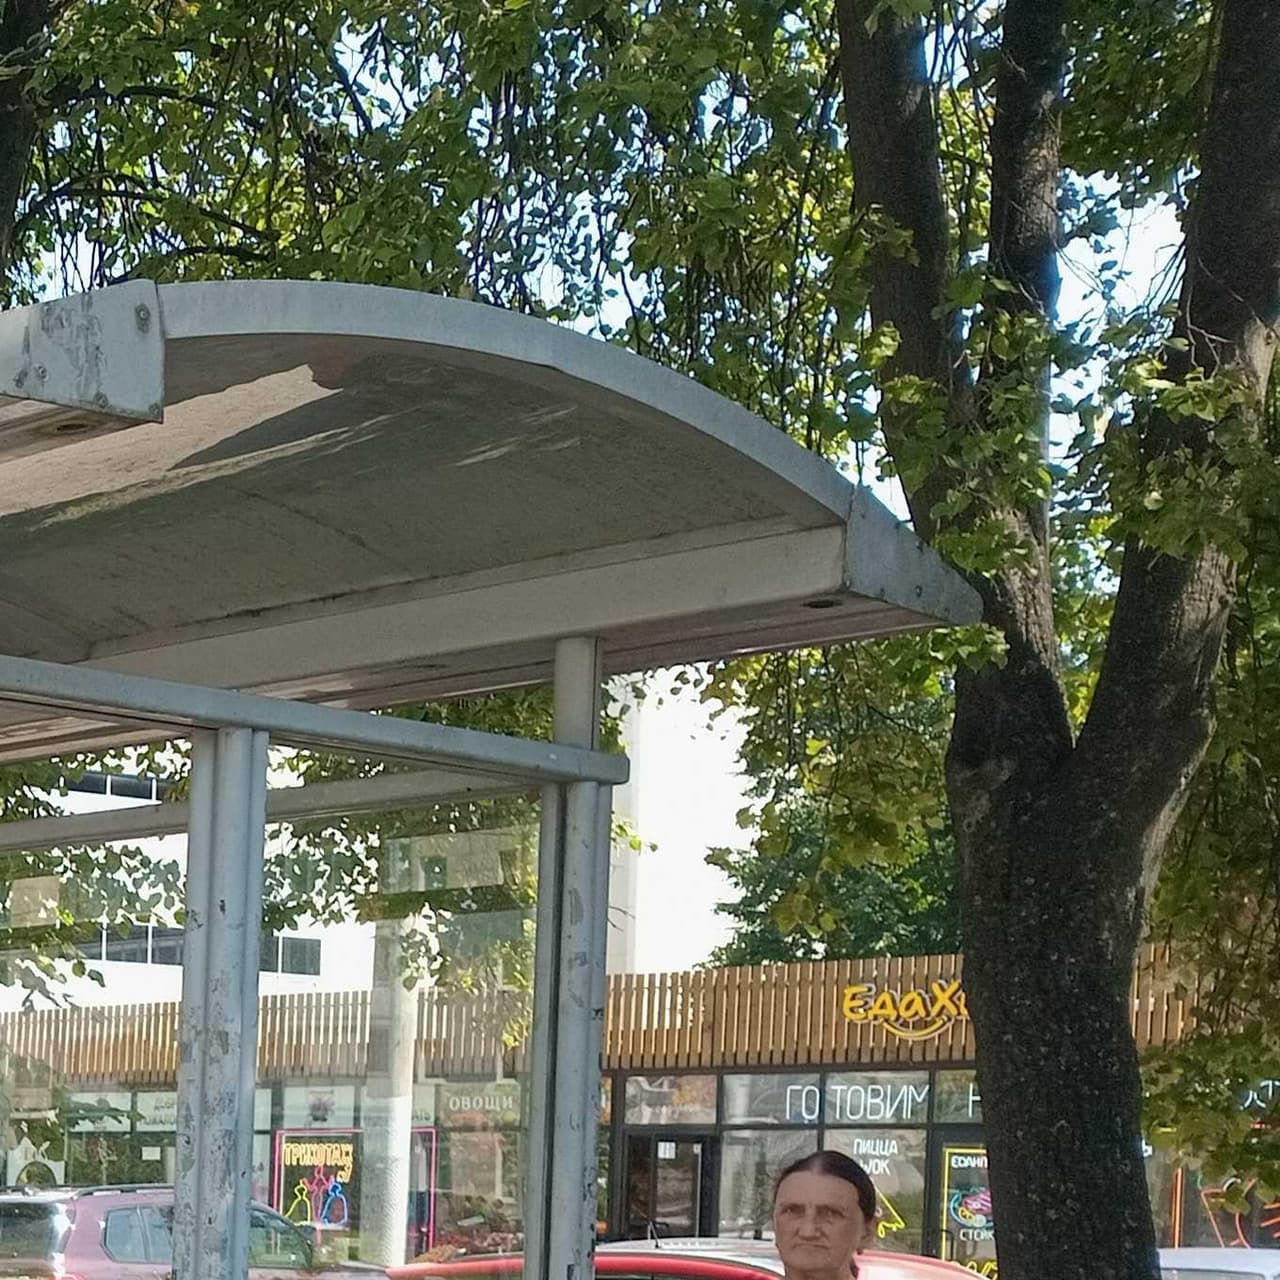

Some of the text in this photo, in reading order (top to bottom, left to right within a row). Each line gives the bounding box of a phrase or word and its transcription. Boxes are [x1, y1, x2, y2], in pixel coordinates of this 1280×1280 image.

[449, 1096, 513, 1112] ОВОЩИ
[282, 1143, 354, 1167] ТРИКОТАЖ
[853, 1138, 898, 1155] ПИЦЦА
